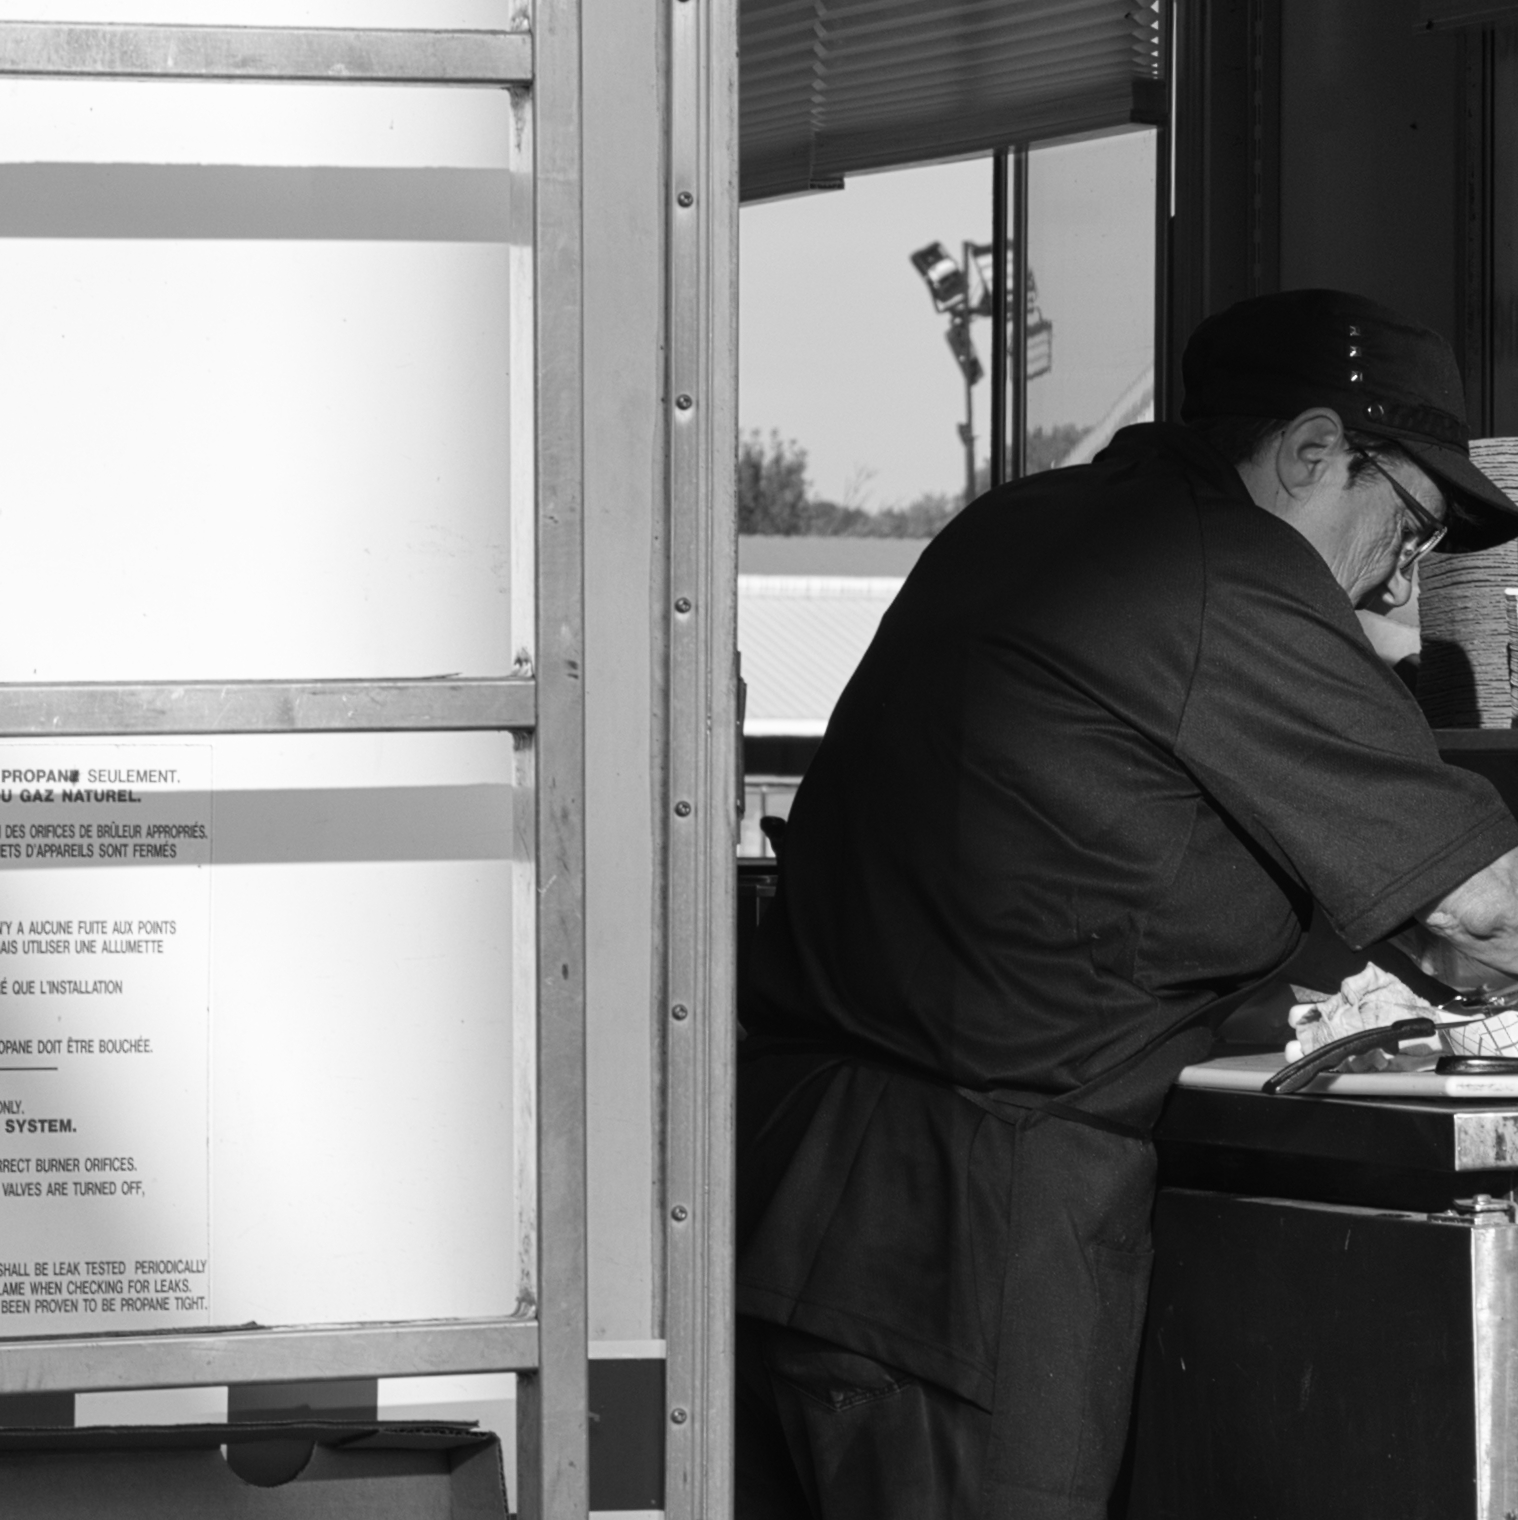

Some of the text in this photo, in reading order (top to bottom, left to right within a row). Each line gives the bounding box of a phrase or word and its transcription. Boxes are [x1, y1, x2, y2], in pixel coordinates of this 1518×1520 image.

[2, 769, 180, 784] PROPAN SEULEMENT.
[20, 789, 55, 803] GAZ
[62, 789, 142, 803] NATUREL.
[5, 824, 25, 839] DES
[30, 824, 75, 839] ORIFICES
[79, 824, 92, 838] DE
[97, 821, 142, 839] BRÛLEUR
[26, 843, 94, 858] D'APPAREILS
[99, 843, 129, 858] SONT
[133, 841, 177, 858] FERMÉS
[17, 921, 24, 934] A
[29, 921, 73, 935] AUCUNE
[78, 921, 107, 935] FUITE
[112, 921, 133, 935] AUX
[138, 921, 176, 935] POINTS
[23, 940, 70, 954] UTILISER
[75, 940, 96, 954] UNE
[102, 940, 163, 954] ALLUMETTE
[12, 980, 35, 995] QUE
[40, 980, 122, 995] L'INSTALLATION
[38, 1039, 62, 1054] DOIT
[67, 1037, 94, 1054] ÊTRE
[99, 1037, 153, 1053] BOUCHÉE.
[5, 1119, 76, 1133] SYSTEM.
[36, 1158, 80, 1173] BURNER
[84, 1157, 137, 1172] ORIFICES.
[2, 1181, 144, 1197] VALVES ARE TURNED OFF,
[35, 1262, 48, 1276] BE
[53, 1262, 80, 1276] LEAK
[85, 1261, 126, 1276] TESTED
[135, 1259, 206, 1274] PERIODICALLY
[0, 1278, 191, 1296] AME WHEN CHECKING FOR LEAKS.
[1, 1296, 207, 1314] BEEN PROVEN TO BE PROPANE TIGHT.
